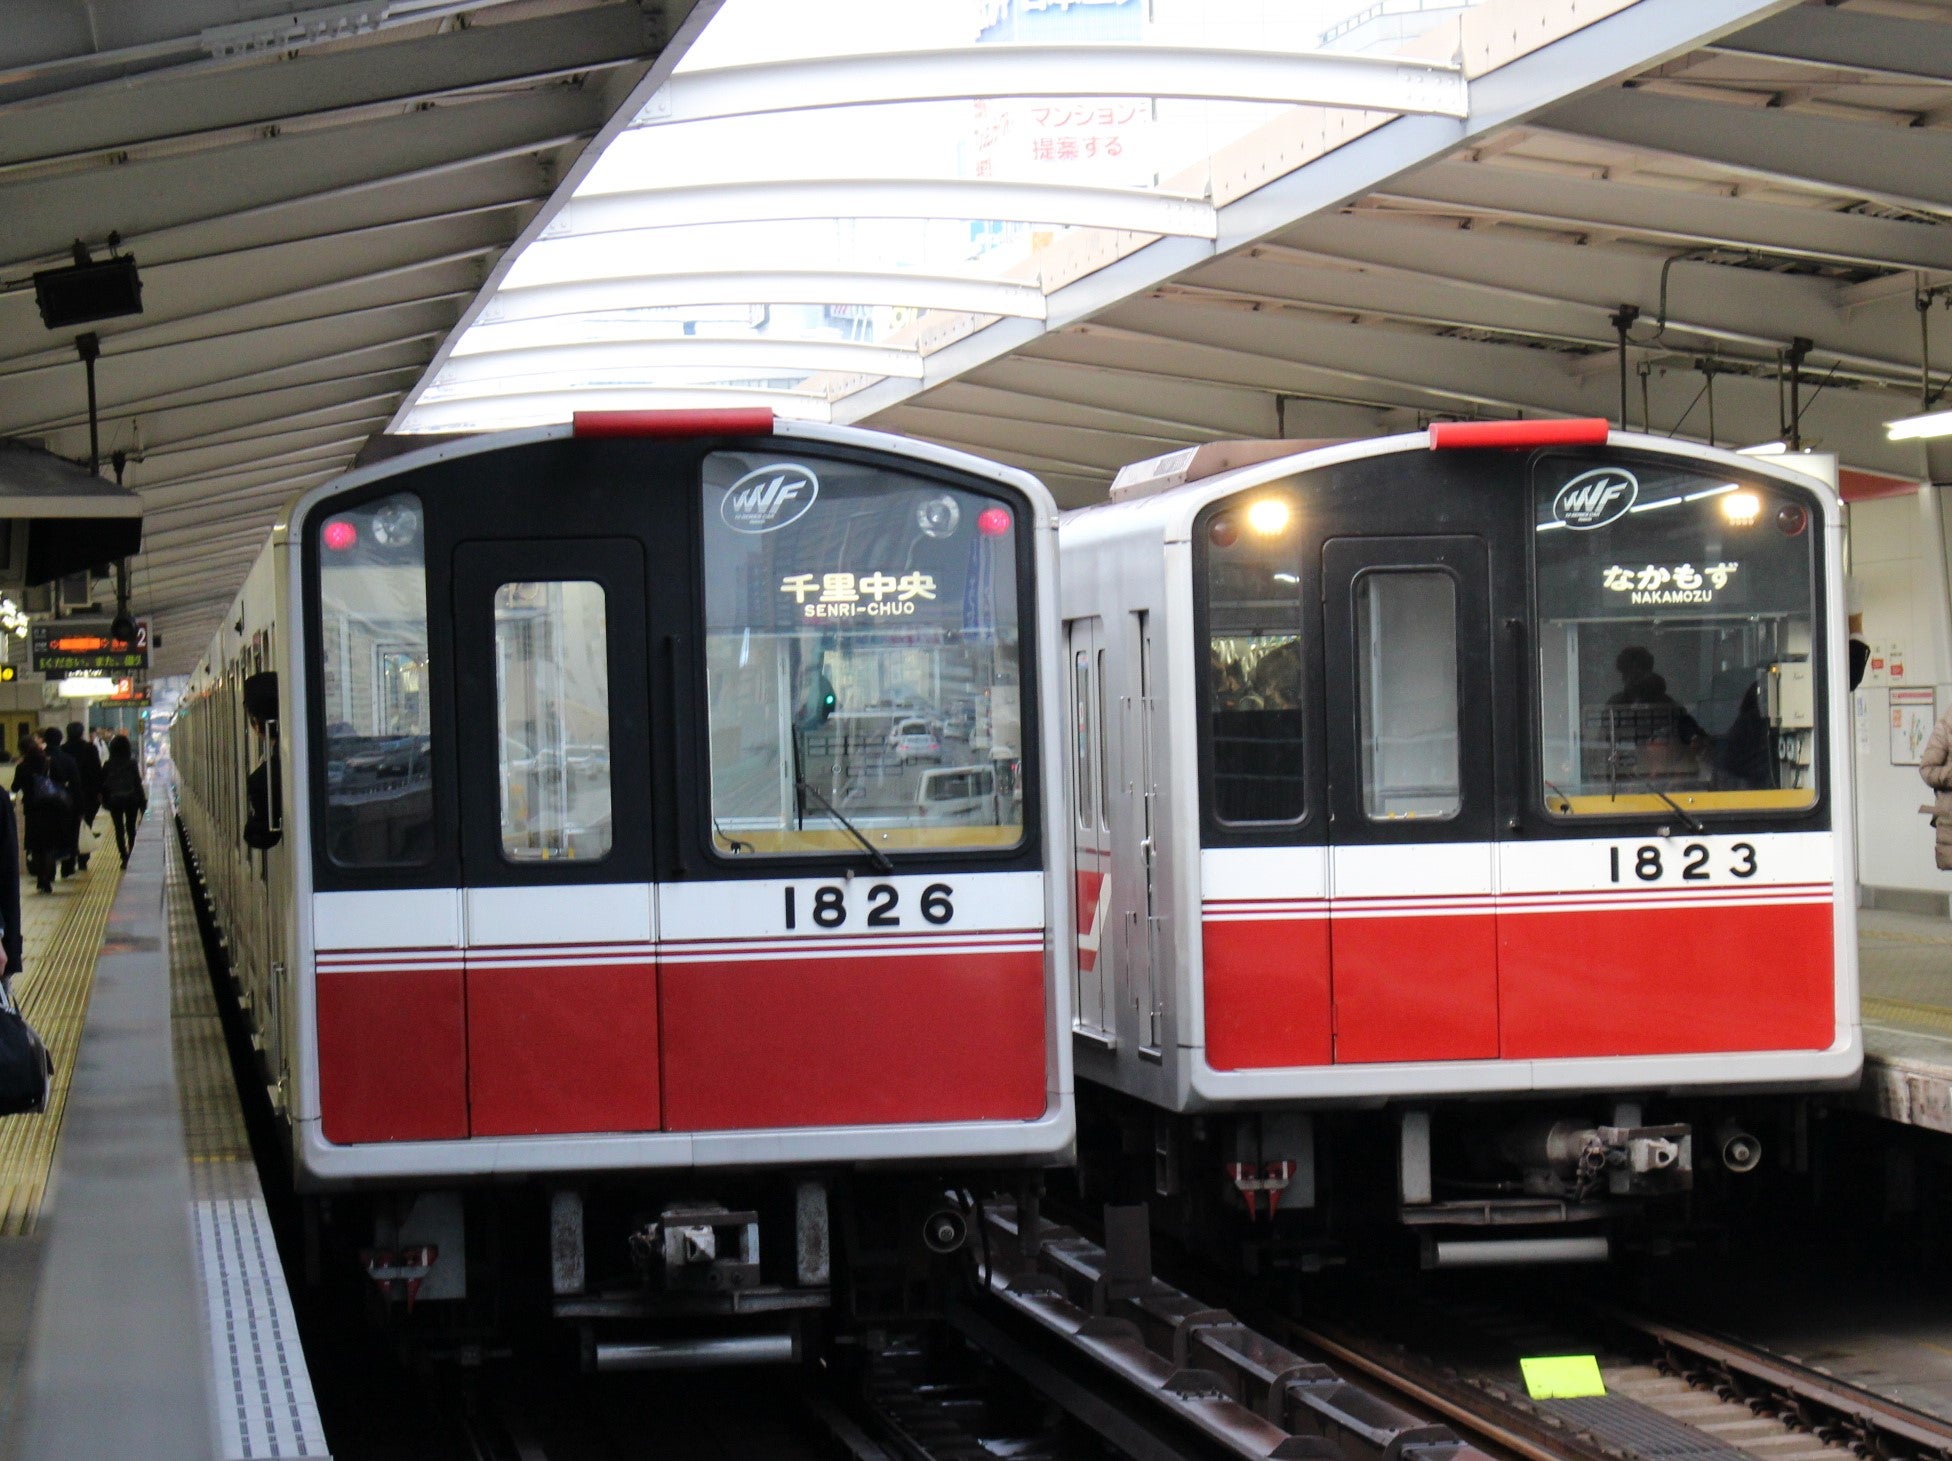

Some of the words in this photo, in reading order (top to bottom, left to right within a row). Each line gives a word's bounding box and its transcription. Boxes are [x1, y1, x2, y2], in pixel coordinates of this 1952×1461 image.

[1033, 136, 1122, 160] 提案する
[780, 571, 937, 603] 千里中央
[1603, 562, 1739, 591] なかもず
[804, 601, 915, 617] SENRI-CHUO
[1631, 589, 1712, 605] NAKAMOZU
[137, 627, 147, 648] 2
[1610, 842, 1757, 883] 1823
[784, 883, 954, 930] 1826
